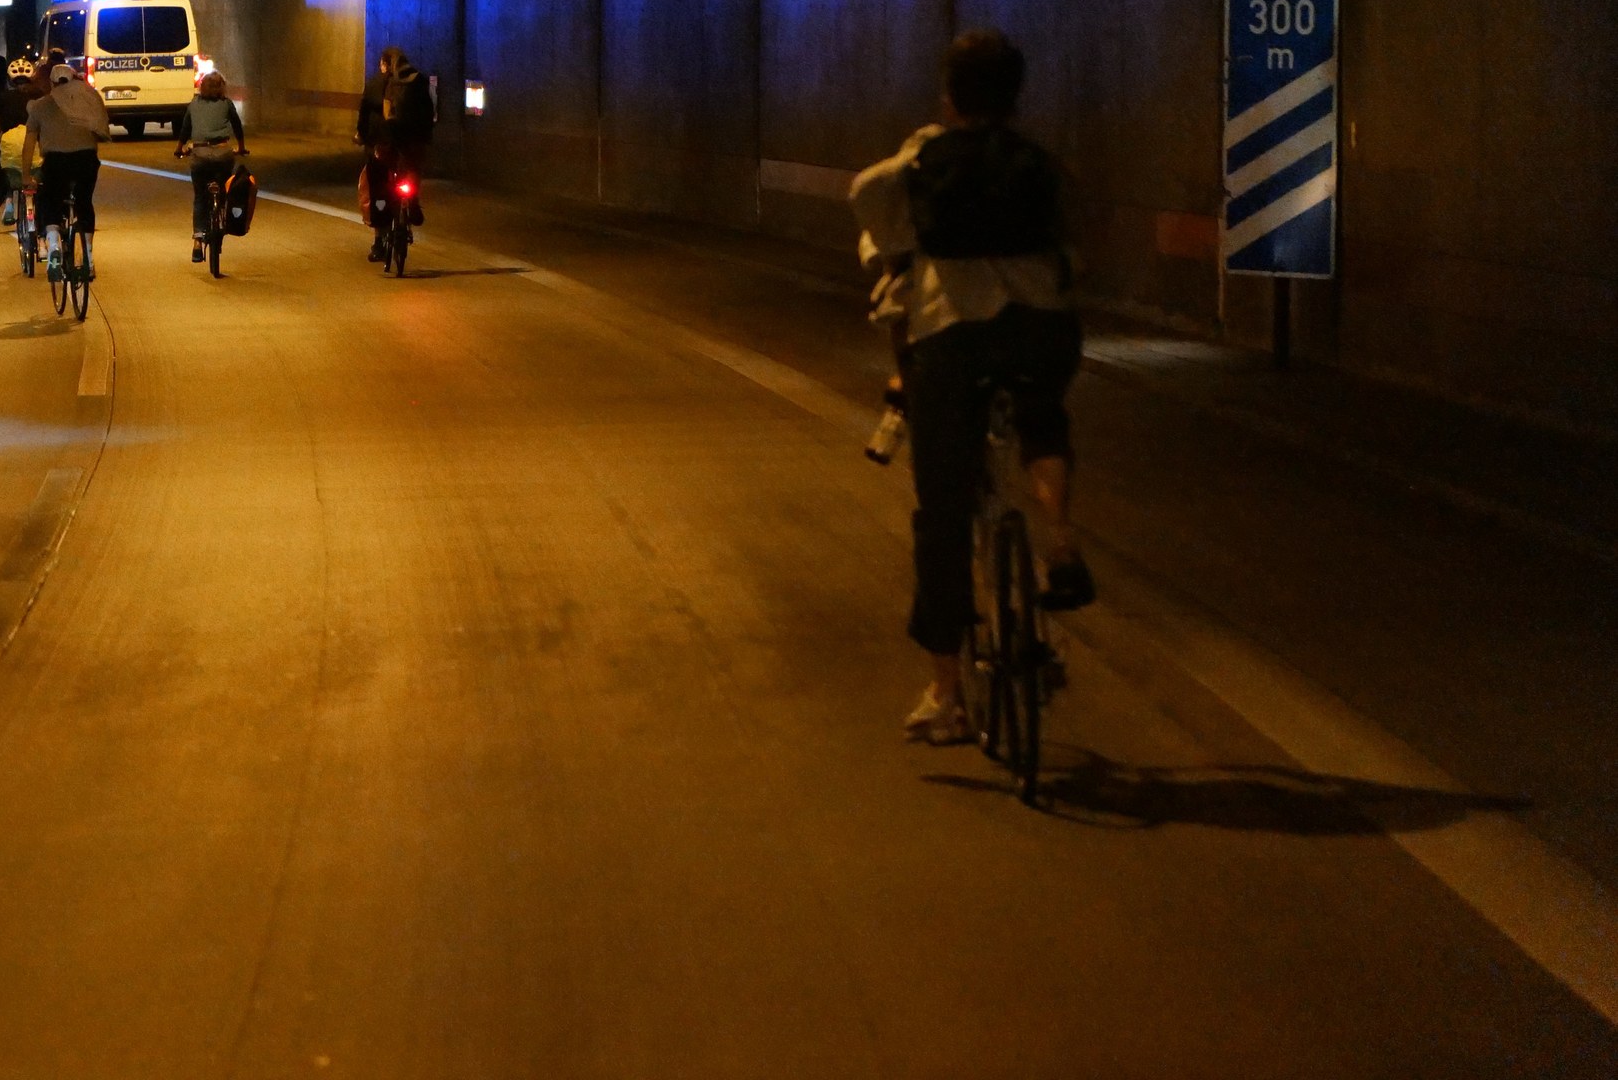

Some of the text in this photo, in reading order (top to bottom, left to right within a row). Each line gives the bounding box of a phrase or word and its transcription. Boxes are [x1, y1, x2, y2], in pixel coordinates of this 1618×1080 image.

[175, 57, 184, 65] E1
[1266, 47, 1295, 70] m
[97, 59, 138, 70] POLIZEI
